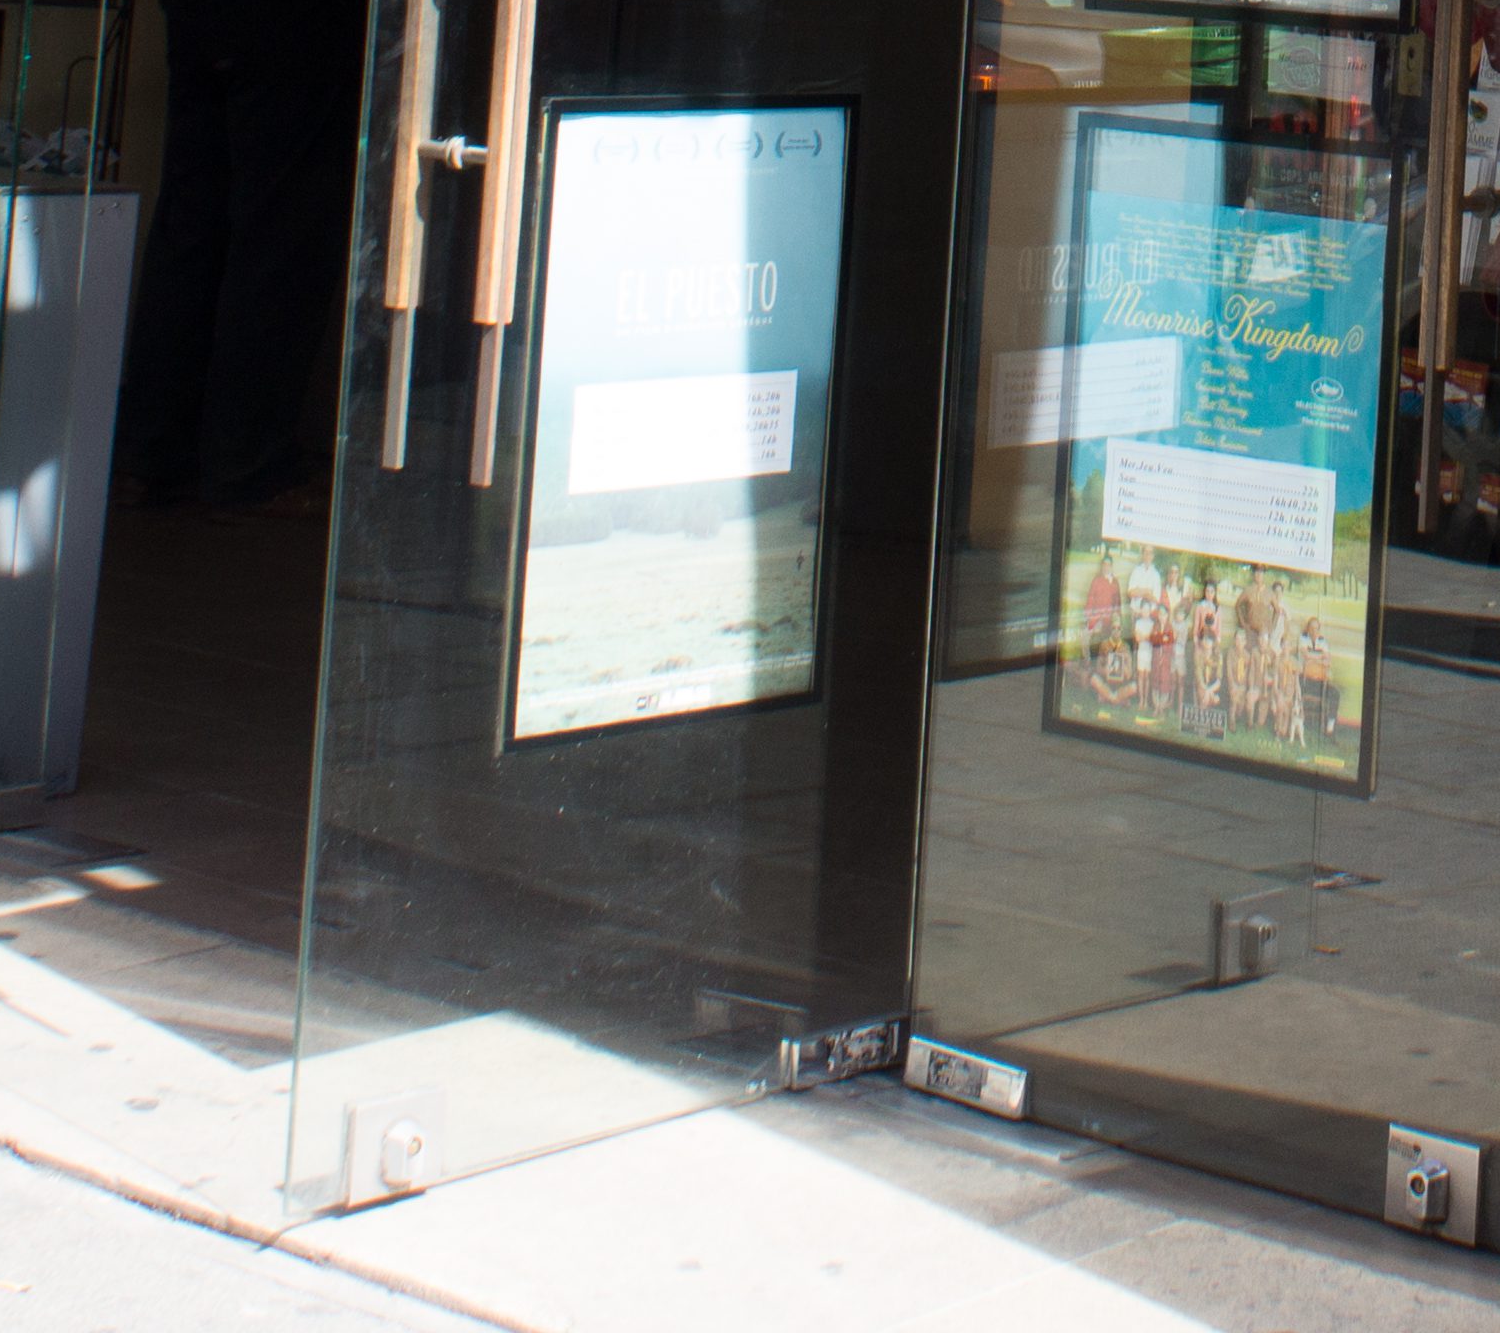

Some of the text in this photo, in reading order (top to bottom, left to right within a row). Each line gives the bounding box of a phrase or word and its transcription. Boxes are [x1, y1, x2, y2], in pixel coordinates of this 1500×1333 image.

[666, 261, 779, 320] PUESTO
[1099, 265, 1364, 363] Moonrise Kingdom
